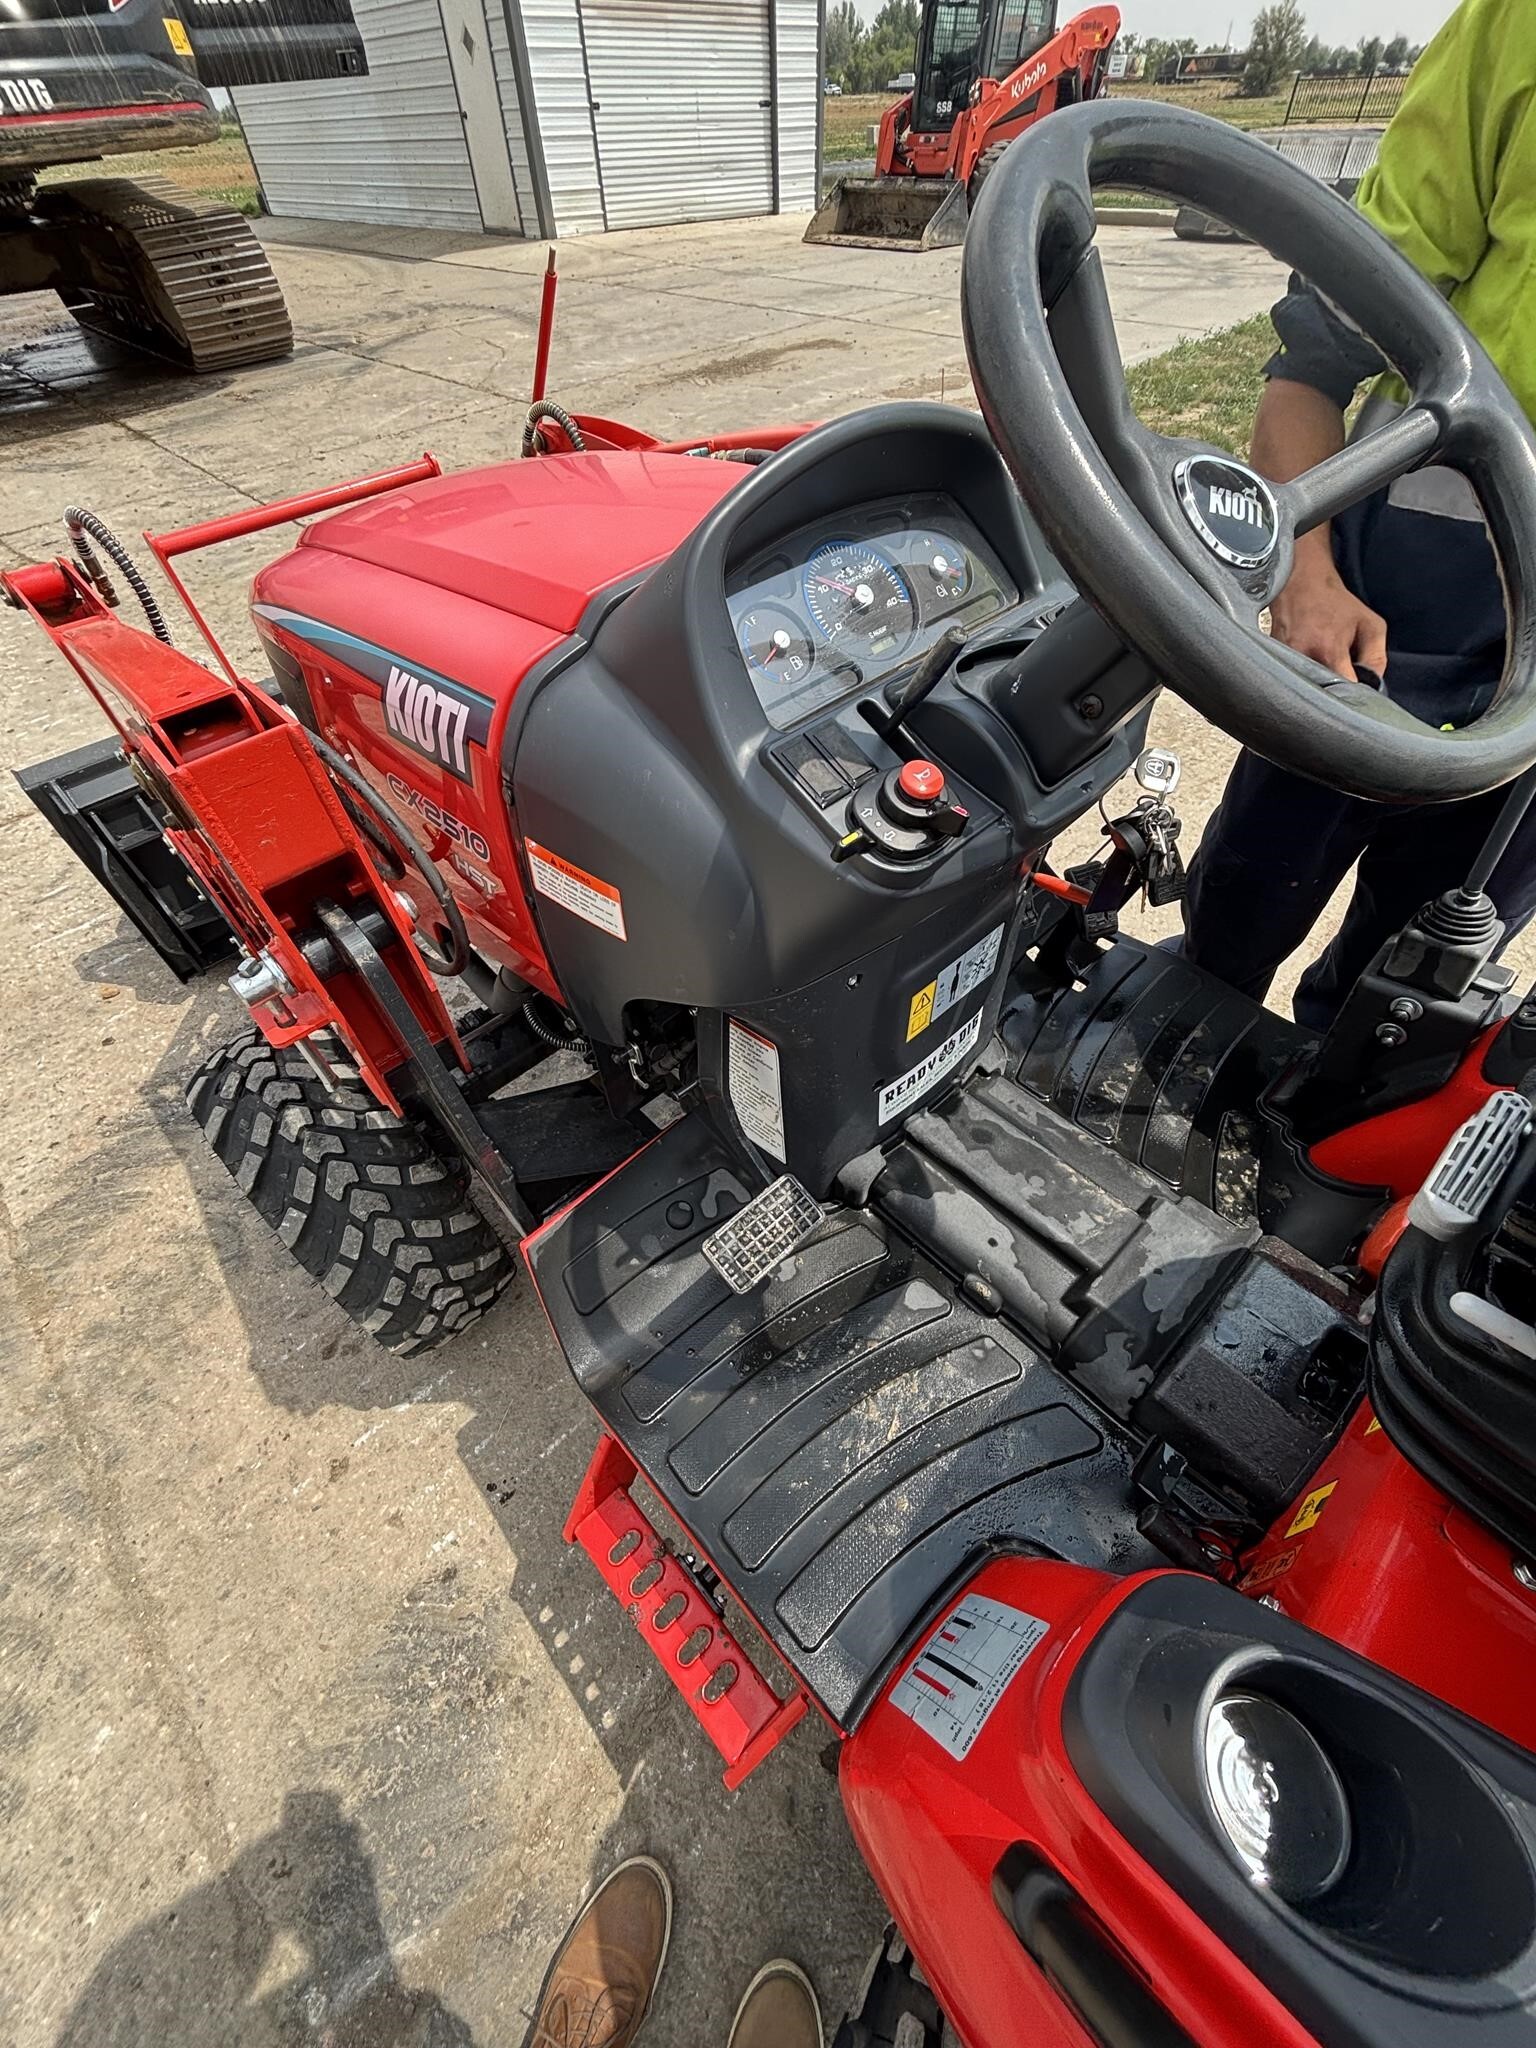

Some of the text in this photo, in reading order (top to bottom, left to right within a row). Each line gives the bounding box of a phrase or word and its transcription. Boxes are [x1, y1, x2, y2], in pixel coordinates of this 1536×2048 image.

[1012, 62, 1046, 98] Kubota
[1209, 485, 1262, 528] KIOTI
[831, 556, 843, 567] 20
[861, 565, 874, 574] 30
[818, 584, 829, 594] 10
[952, 588, 958, 596] C
[886, 597, 898, 608] 40
[750, 616, 757, 625] F
[835, 622, 843, 631] 0
[784, 671, 791, 680] E
[386, 665, 470, 774] KIOTI
[386, 772, 491, 863] CX2510
[455, 854, 497, 896] HST
[558, 862, 592, 885] WARNING
[885, 1055, 937, 1105] READY
[959, 1014, 980, 1044] DIG
[960, 1631, 1043, 1752] Traveling speed at engine 2,600
